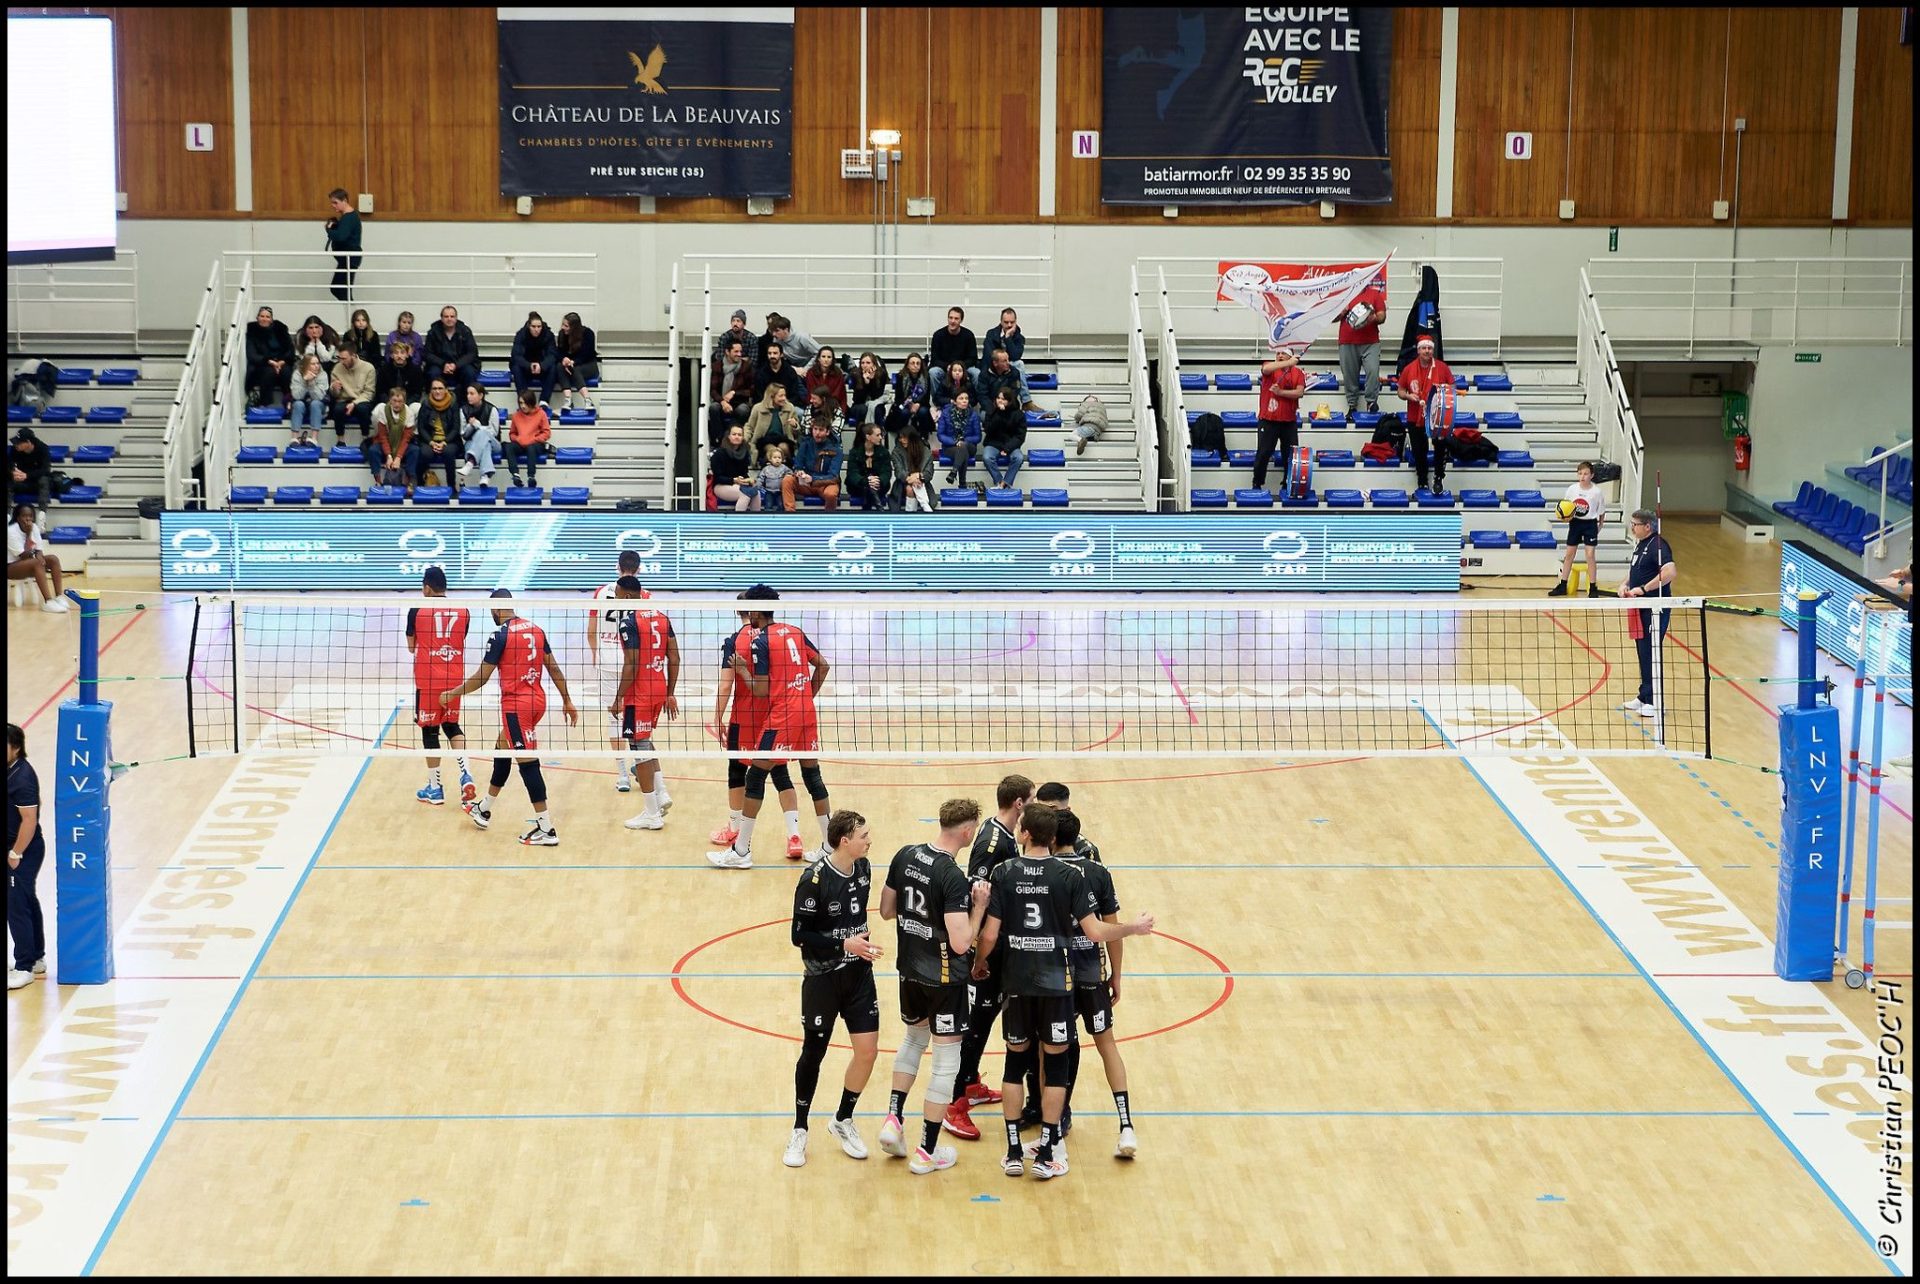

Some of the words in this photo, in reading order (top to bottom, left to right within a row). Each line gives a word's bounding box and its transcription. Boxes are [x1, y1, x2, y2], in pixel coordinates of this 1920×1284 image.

[1243, 28, 1322, 51] AVEC
[1330, 28, 1360, 52] LE
[1242, 57, 1302, 87] REC
[1264, 85, 1338, 104] VOLLEY
[512, 103, 611, 124] CHÂTEAU
[618, 107, 644, 123] DE
[652, 105, 677, 124] LA
[686, 105, 781, 125] BEAUVAIS
[194, 127, 204, 147] L
[518, 138, 582, 148] CHAMBRES
[646, 136, 672, 148] GÎTE
[678, 138, 690, 148] ET
[1079, 135, 1092, 154] N
[590, 165, 612, 176] PIRÉ
[617, 167, 638, 177] SUR
[640, 167, 678, 178] SEICHE
[682, 166, 704, 178] (35)
[1144, 166, 1234, 182] batiarmor.fr
[1244, 167, 1262, 180] 02
[1266, 167, 1286, 180] 99
[1289, 167, 1307, 180] 35
[1310, 167, 1328, 180] 35
[1332, 167, 1351, 180] 90
[1144, 188, 1189, 196] PROMOTEUR
[1264, 186, 1303, 194] RÉFÉRENCE
[1316, 187, 1351, 195] BRETAGNE
[172, 562, 220, 574] STAR
[828, 563, 874, 576] STAR
[1050, 564, 1095, 576] STAR
[1262, 564, 1308, 576] STAR
[434, 612, 458, 638] 17
[650, 620, 660, 649] 5
[522, 633, 537, 661] 3
[786, 638, 801, 666] 4
[1016, 886, 1049, 894] GIBOIRE
[850, 896, 860, 915] 6
[904, 886, 928, 917] 12
[1025, 902, 1042, 928] 3
[814, 1016, 822, 1026] 6
